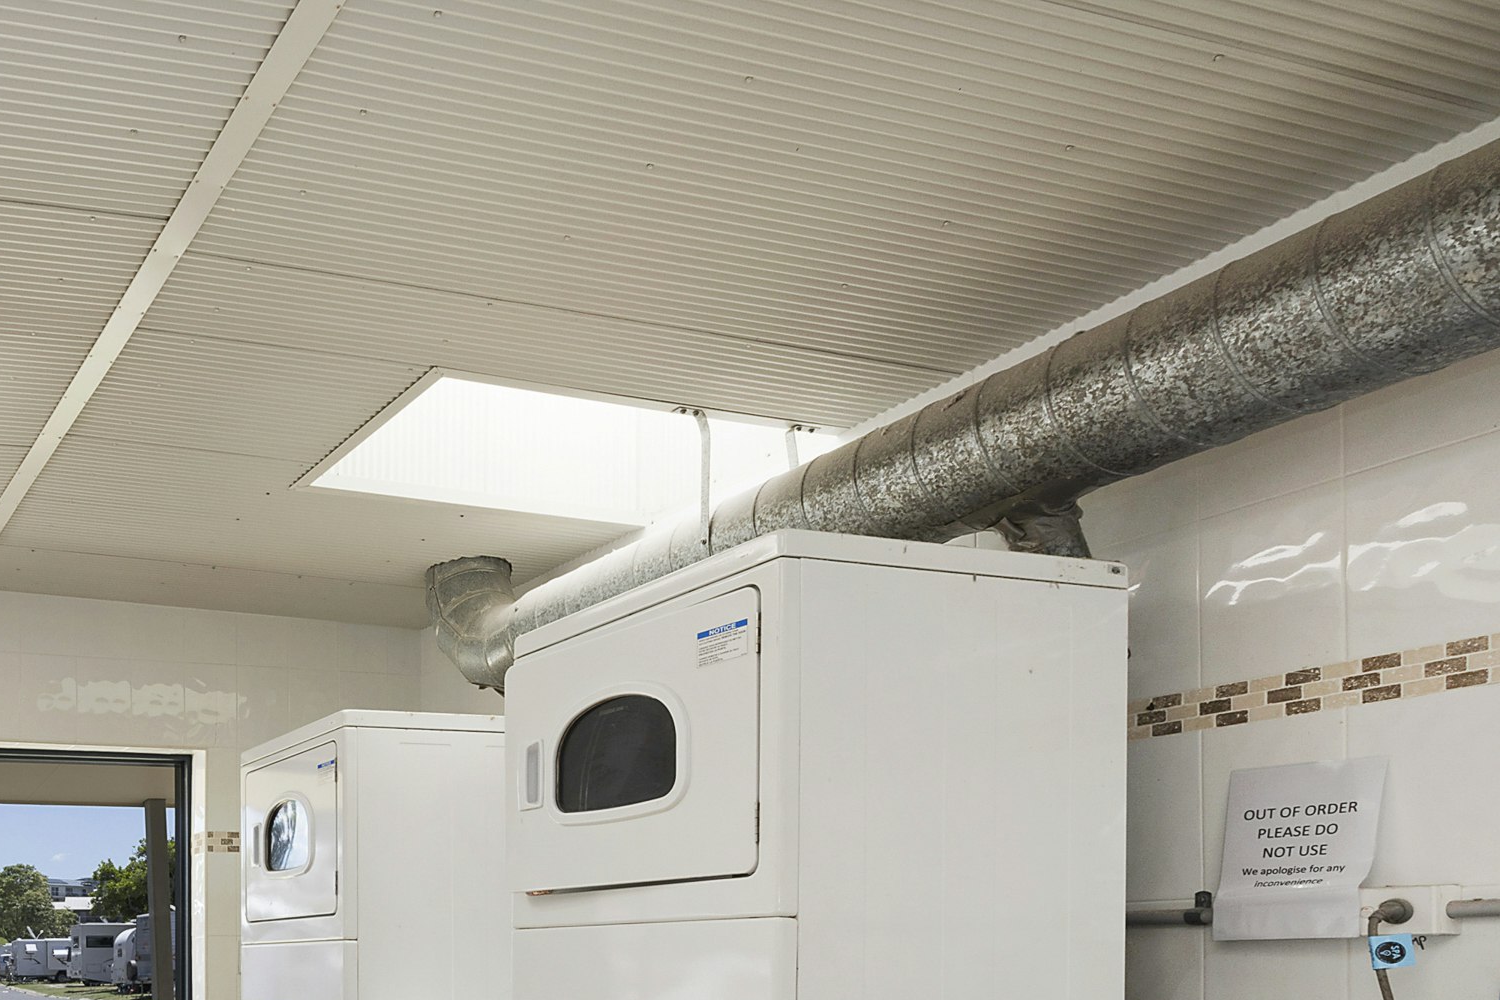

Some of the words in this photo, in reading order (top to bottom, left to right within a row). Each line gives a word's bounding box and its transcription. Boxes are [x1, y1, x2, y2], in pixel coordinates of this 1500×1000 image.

[708, 622, 736, 636] NOTICE
[1243, 807, 1276, 821] OUT
[1280, 805, 1300, 819] OF
[1304, 801, 1359, 817] ORDER
[1257, 825, 1311, 840] PLEASE
[1314, 823, 1339, 836] DO
[1262, 846, 1295, 859] NOT
[1299, 844, 1328, 856] USE
[1241, 867, 1259, 877] We
[1260, 864, 1307, 877] apologise
[1309, 864, 1325, 873] for
[1326, 864, 1346, 874] any
[1253, 877, 1324, 888] inconvenience
